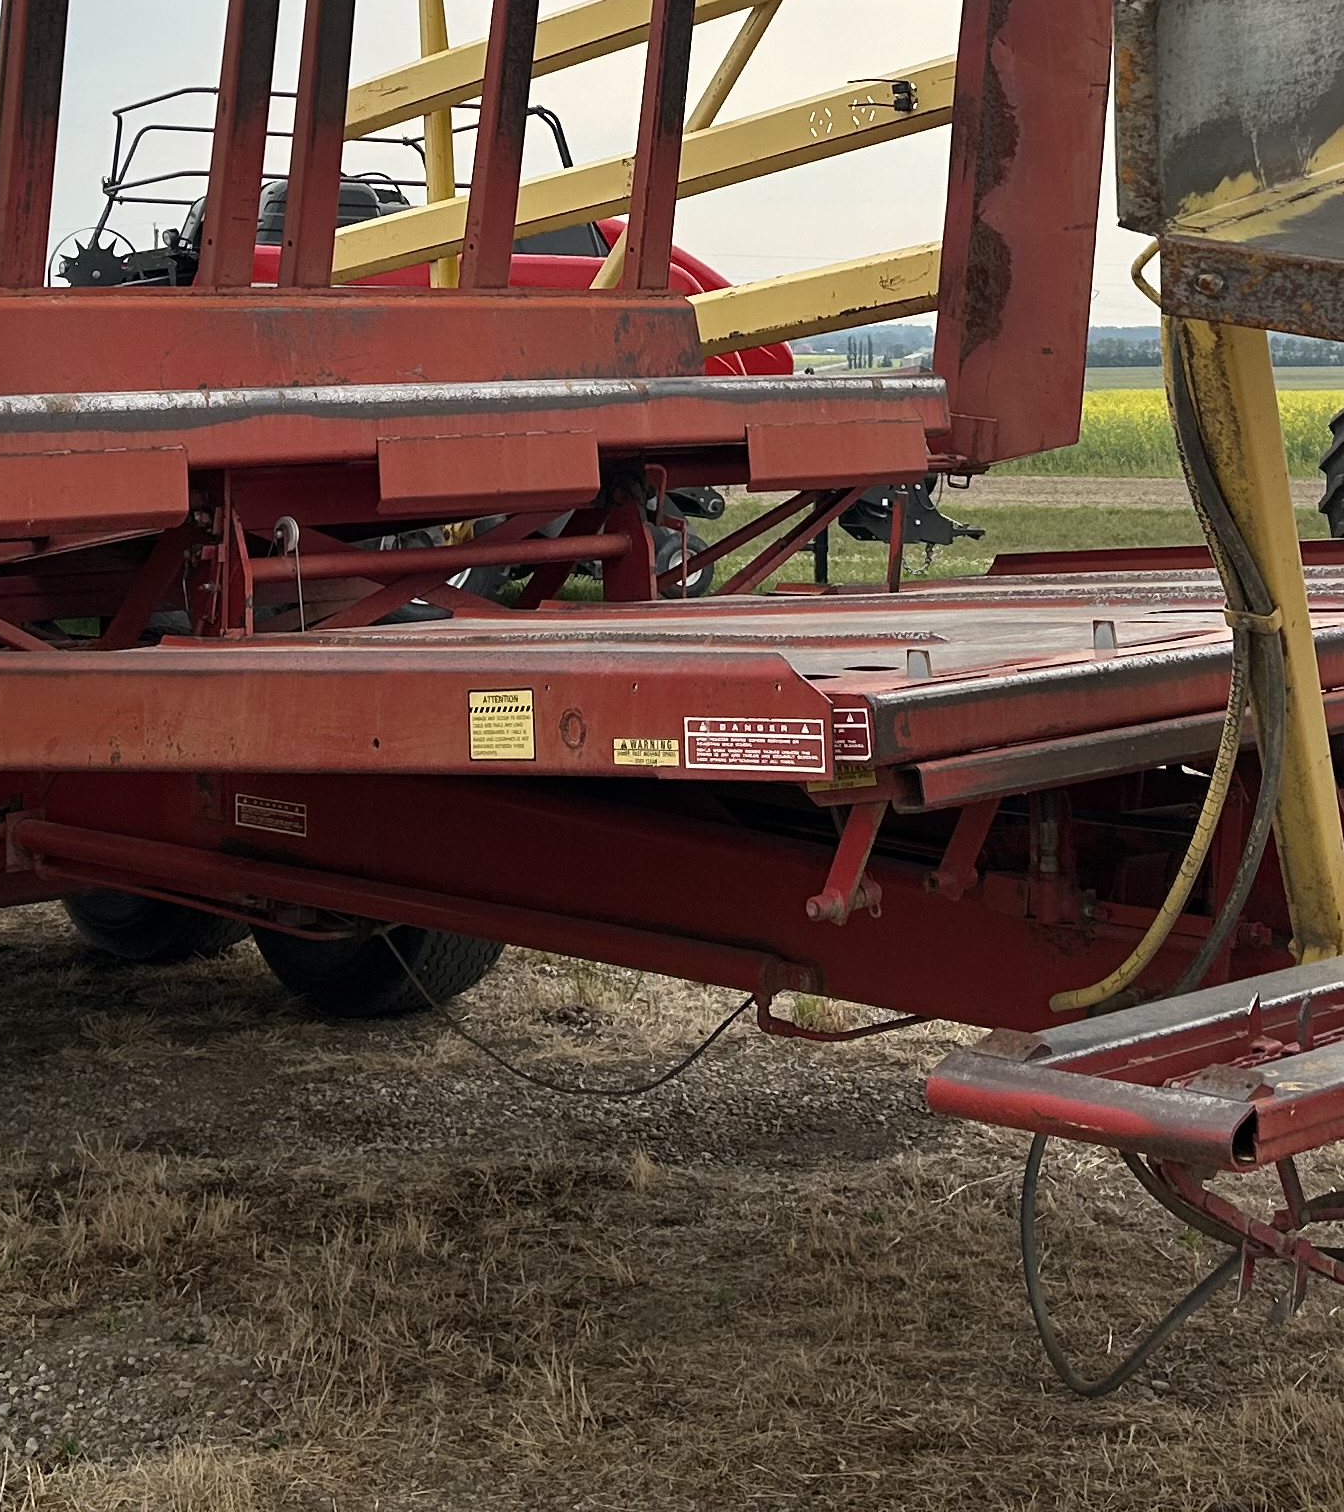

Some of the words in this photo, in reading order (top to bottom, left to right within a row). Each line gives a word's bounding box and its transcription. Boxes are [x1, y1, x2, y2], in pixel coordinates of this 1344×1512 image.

[483, 694, 519, 704] ATTENTION
[719, 723, 788, 733] DANGER
[630, 739, 672, 751] WARNING
